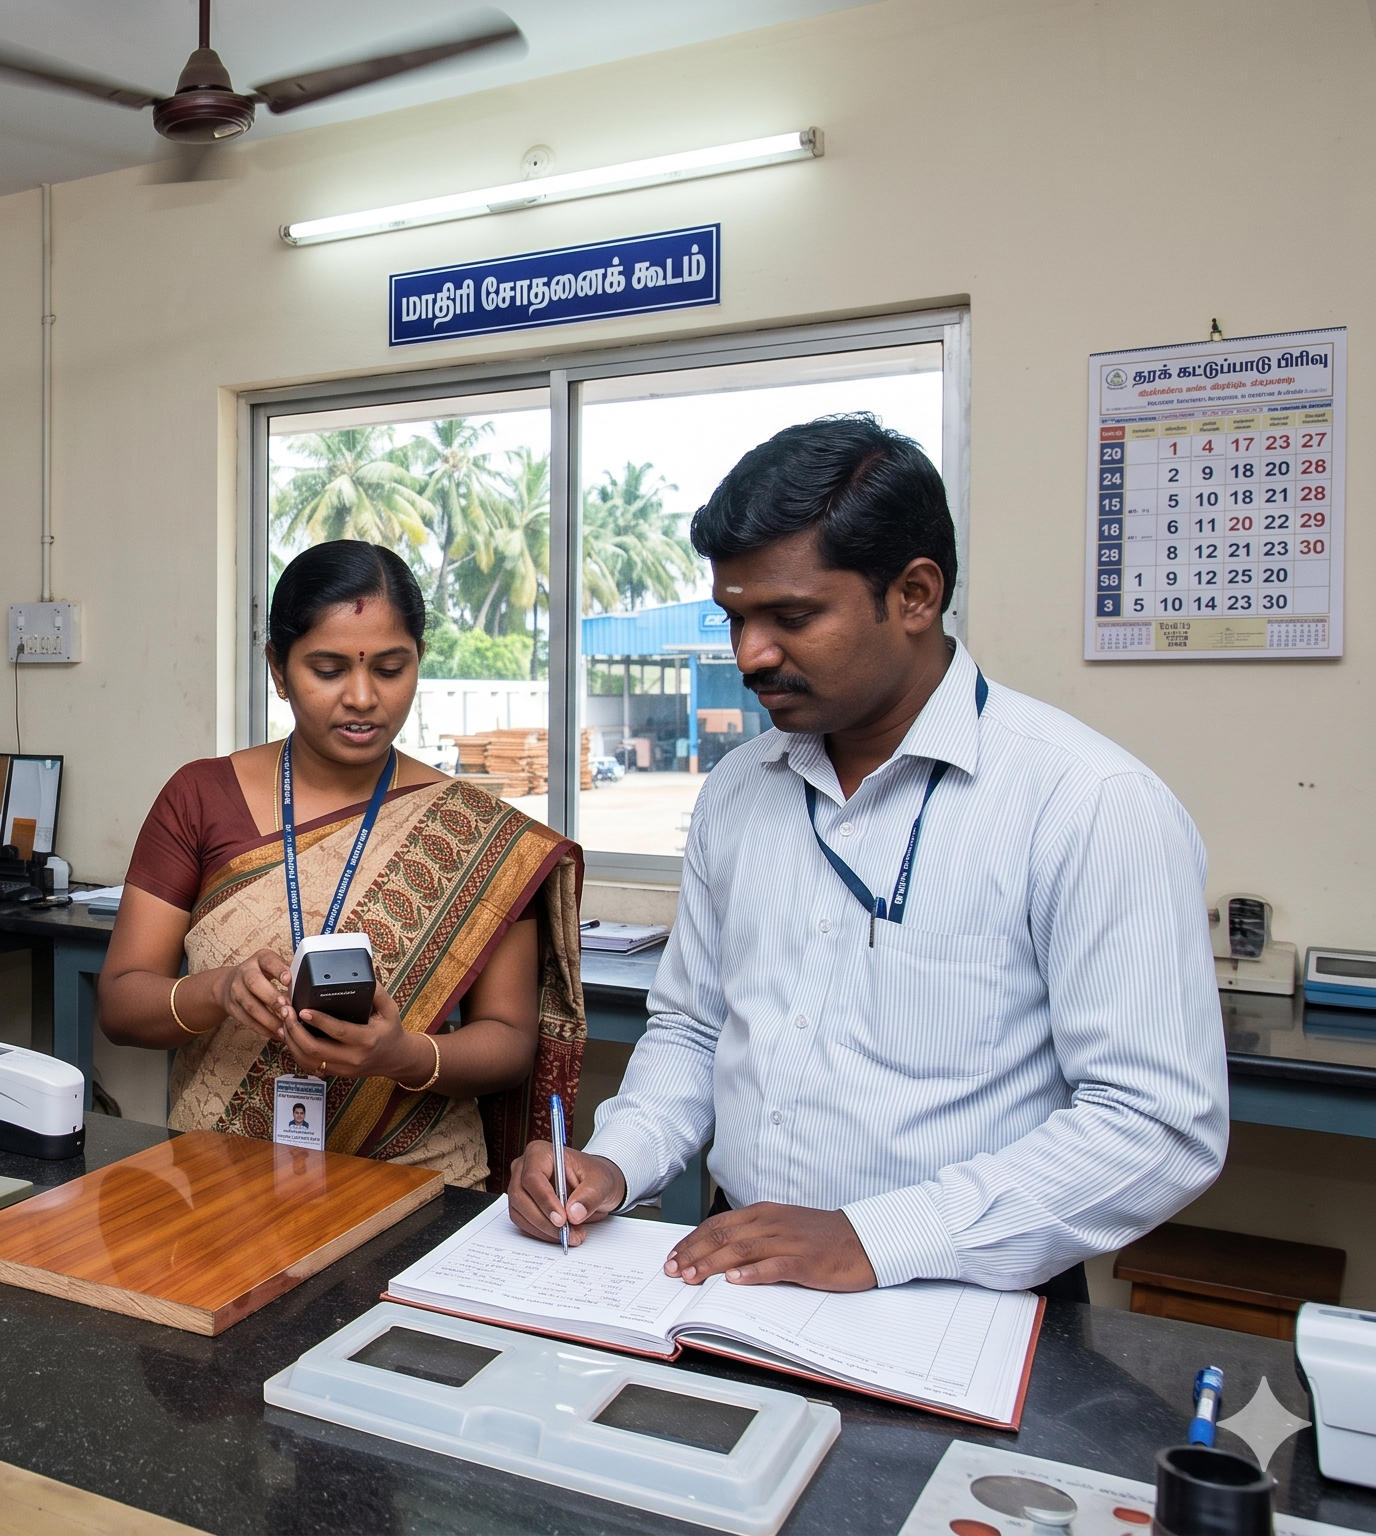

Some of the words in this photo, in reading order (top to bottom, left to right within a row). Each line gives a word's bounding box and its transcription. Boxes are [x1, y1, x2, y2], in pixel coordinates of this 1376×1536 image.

[401, 279, 474, 329] மாதிரி
[481, 256, 625, 316] சோதனைக்
[632, 244, 706, 290] கூடம்
[1133, 364, 1172, 387] தரக்
[1177, 356, 1271, 379] கட்டுப்பாடு
[1278, 350, 1327, 368] பிரிவு
[1170, 442, 1177, 455] 1
[1202, 440, 1213, 453] 4
[1231, 438, 1254, 452] 17
[1266, 435, 1290, 450] 23
[1302, 433, 1327, 448] 27
[1103, 473, 1121, 485] 24
[1168, 468, 1179, 482] 2
[1202, 466, 1213, 480] 9
[1231, 463, 1254, 478] 18
[1265, 461, 1290, 476] 20
[1301, 459, 1326, 474] 28
[1103, 499, 1120, 510] 15
[1168, 494, 1178, 508] 5
[1196, 492, 1218, 506] 10
[1230, 490, 1253, 504] 18
[1265, 488, 1287, 503] 21
[1301, 486, 1325, 501] 28
[1102, 524, 1119, 535] 18
[1168, 520, 1178, 534] 6
[1195, 518, 1215, 532] 11
[1229, 516, 1252, 531] 20
[1264, 514, 1289, 529] 22
[1300, 513, 1325, 528] 29
[1167, 546, 1177, 560] 8
[1195, 544, 1217, 558] 12
[1229, 543, 1250, 557] 21
[1264, 541, 1288, 556] 23
[1300, 540, 1324, 554] 30
[1135, 573, 1142, 586] 1
[1166, 572, 1177, 585] 9
[1194, 571, 1216, 585] 12
[1228, 569, 1252, 583] 25
[1263, 568, 1287, 582] 20
[1104, 600, 1113, 611] 3
[1134, 598, 1144, 612] 5
[1160, 598, 1182, 611] 10
[1194, 597, 1217, 610] 14
[1228, 595, 1251, 610] 23
[1263, 595, 1287, 609] 30
